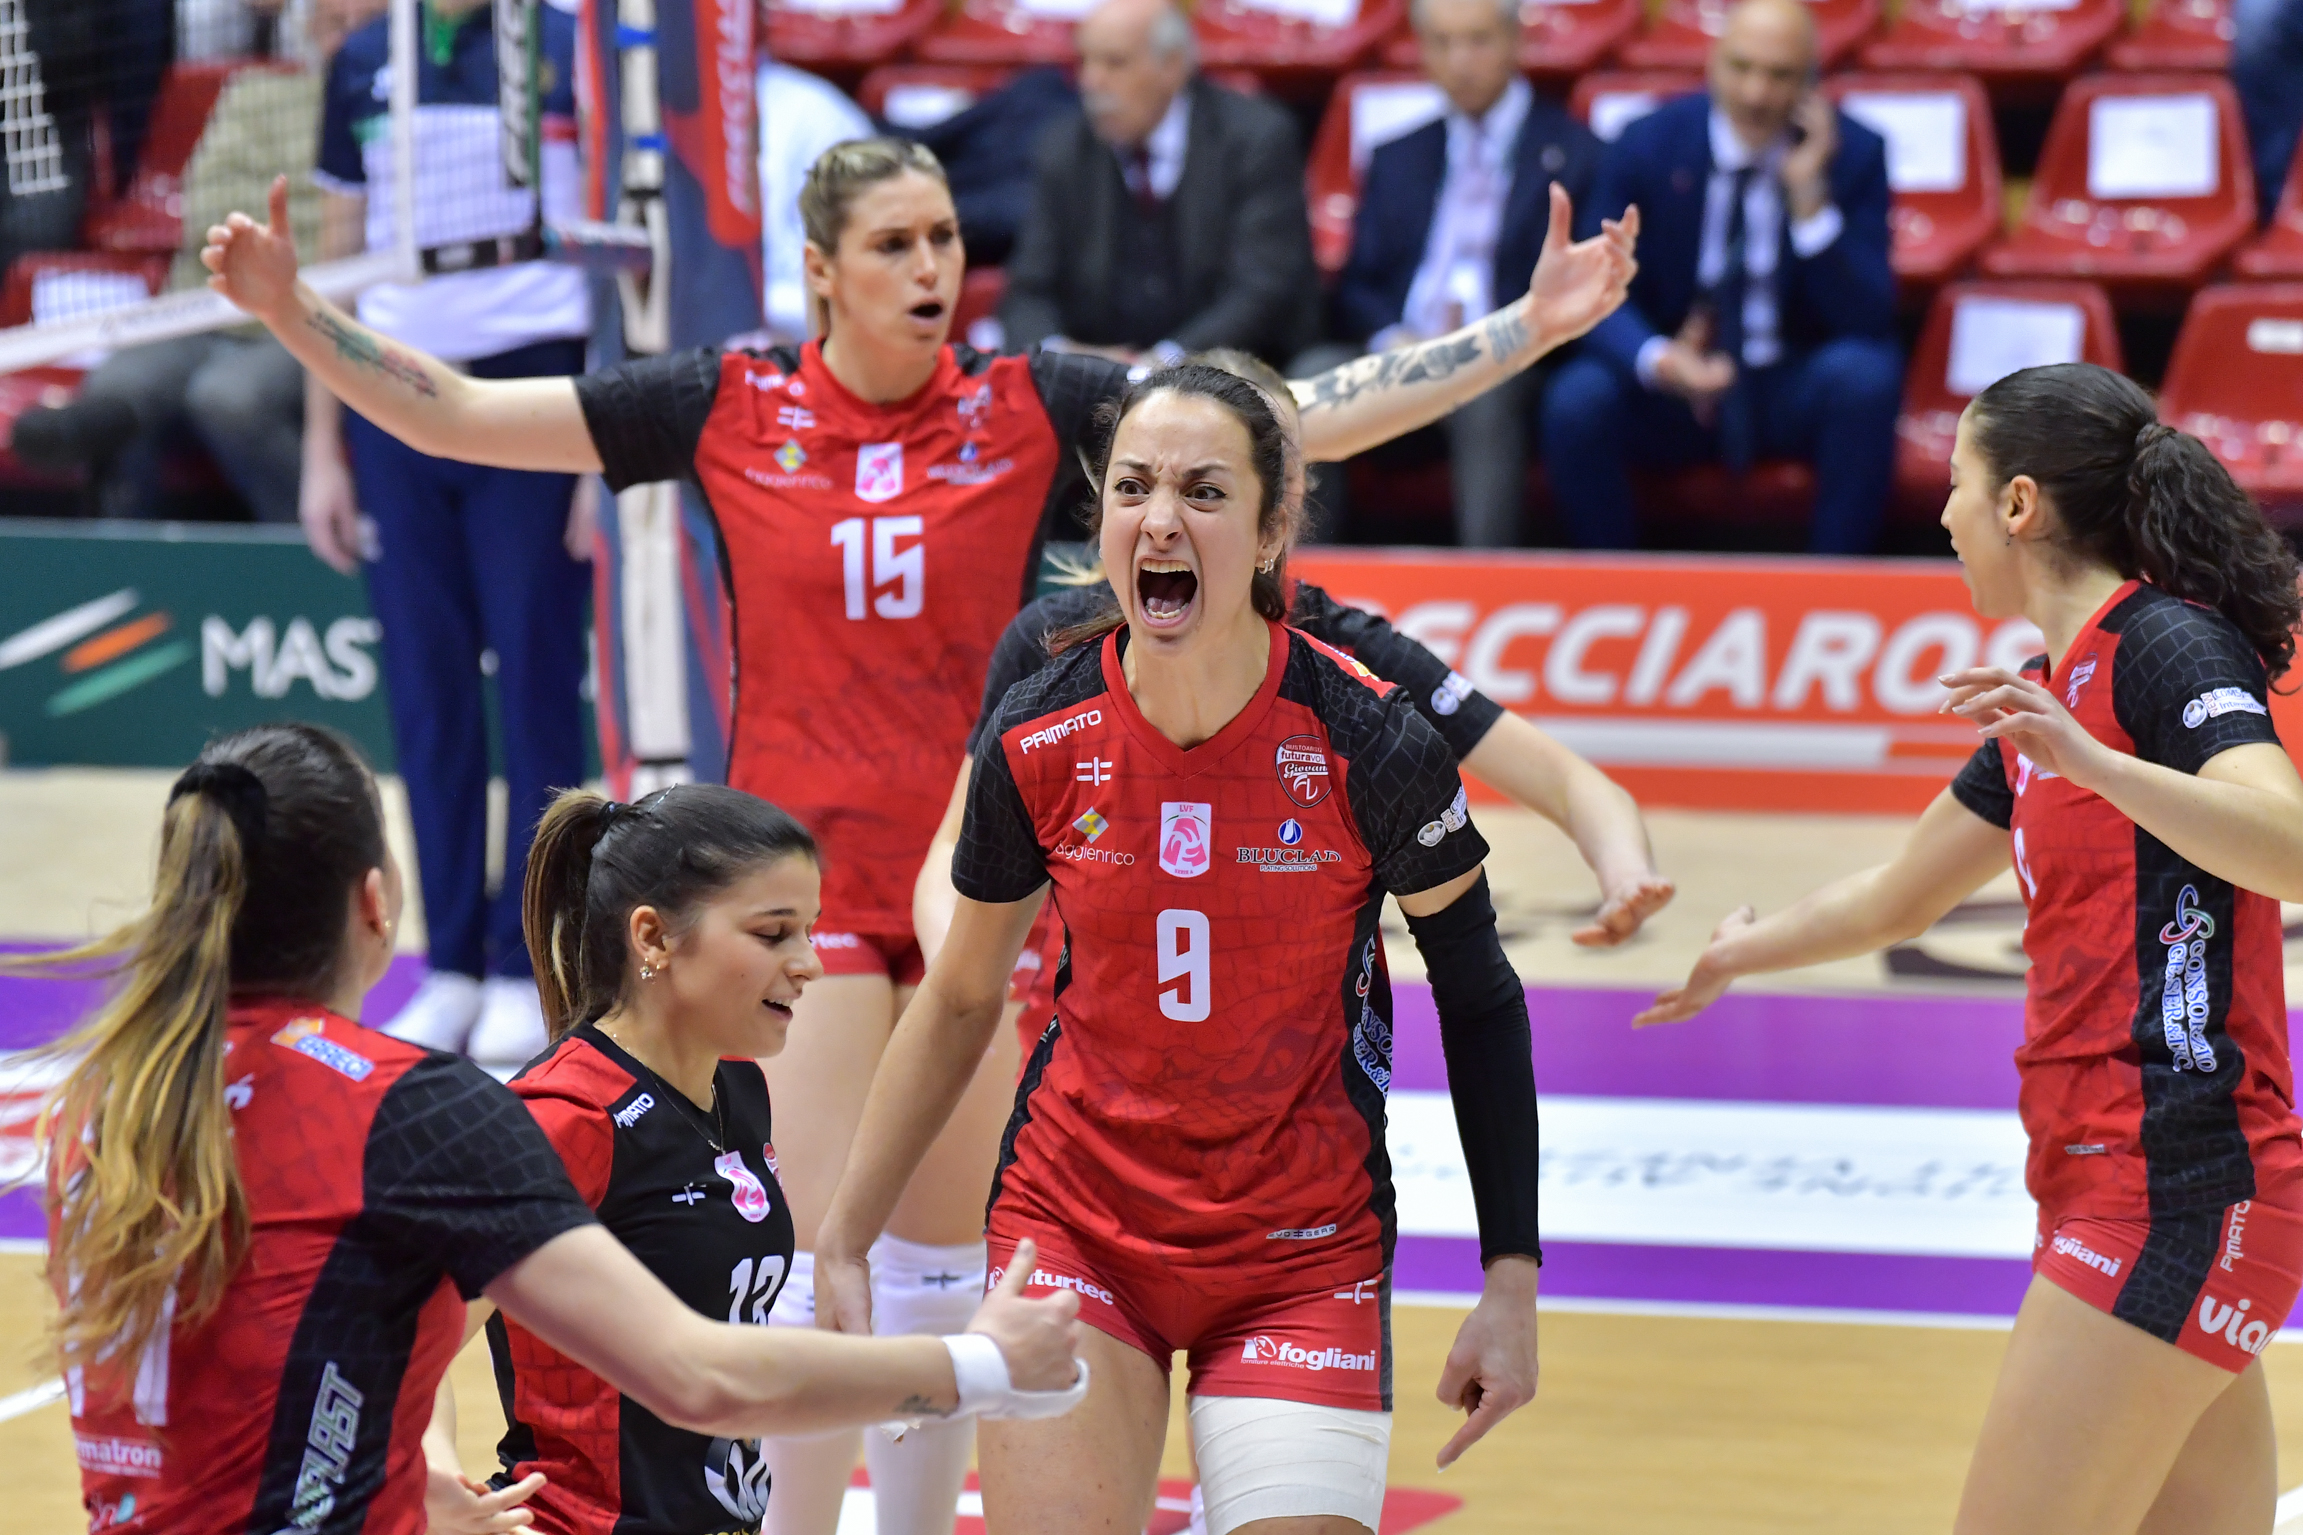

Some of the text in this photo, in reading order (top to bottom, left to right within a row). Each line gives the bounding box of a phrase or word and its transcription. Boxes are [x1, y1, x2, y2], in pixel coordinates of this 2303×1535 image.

[831, 515, 924, 620] 15
[1020, 709, 1102, 755] PRIMATO
[1180, 804, 1194, 813] LVF
[1055, 841, 1135, 866] aggienrico
[1237, 847, 1342, 864] BLUCLAD
[1157, 908, 1211, 1023] 9
[2185, 939, 2217, 1072] CONSORZIO
[1305, 1226, 1336, 1238] GEAR
[1026, 1268, 1114, 1306] turtec
[1278, 1341, 1376, 1371] fogliani
